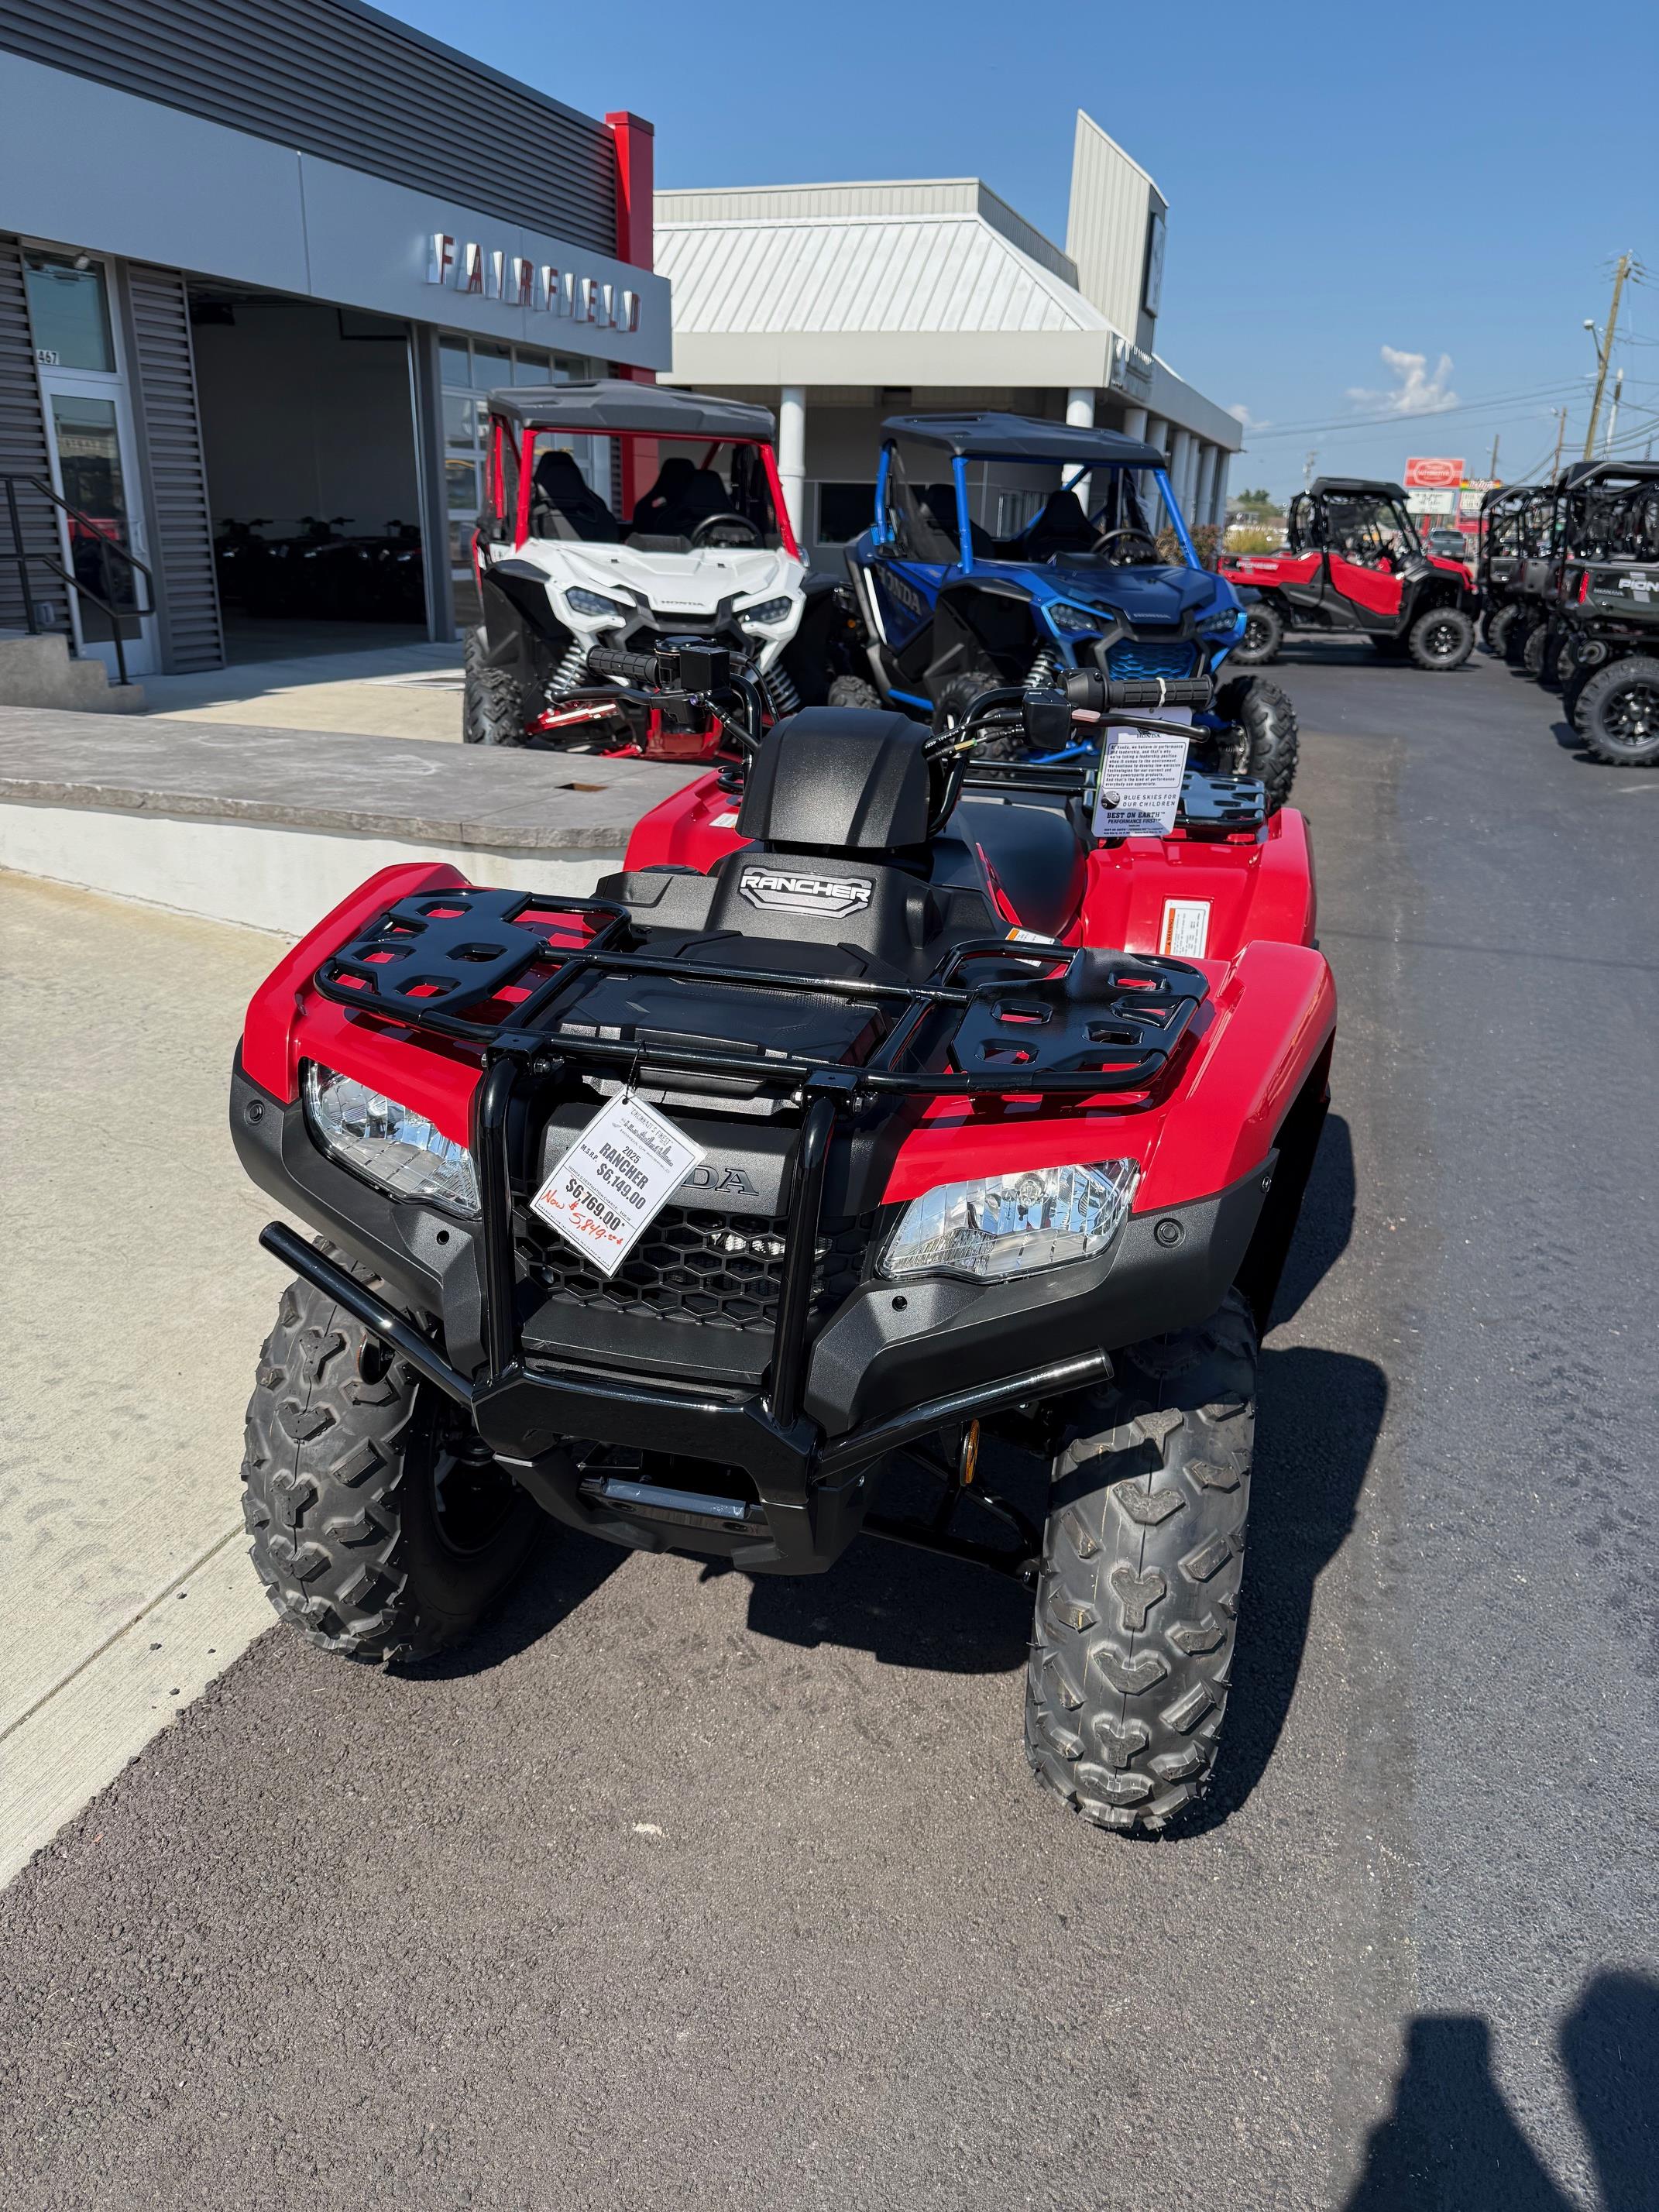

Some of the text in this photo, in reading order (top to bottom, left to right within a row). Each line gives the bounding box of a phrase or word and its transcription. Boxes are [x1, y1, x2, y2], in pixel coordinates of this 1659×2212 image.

[431, 233, 641, 332] FAIRFIELD
[740, 875, 871, 902] RANCHER
[599, 1142, 649, 1190] RANCHER
[622, 1146, 641, 1163] 2025
[580, 1144, 646, 1210] M.S.R.P. $6,149.00
[541, 1189, 565, 1210] Now
